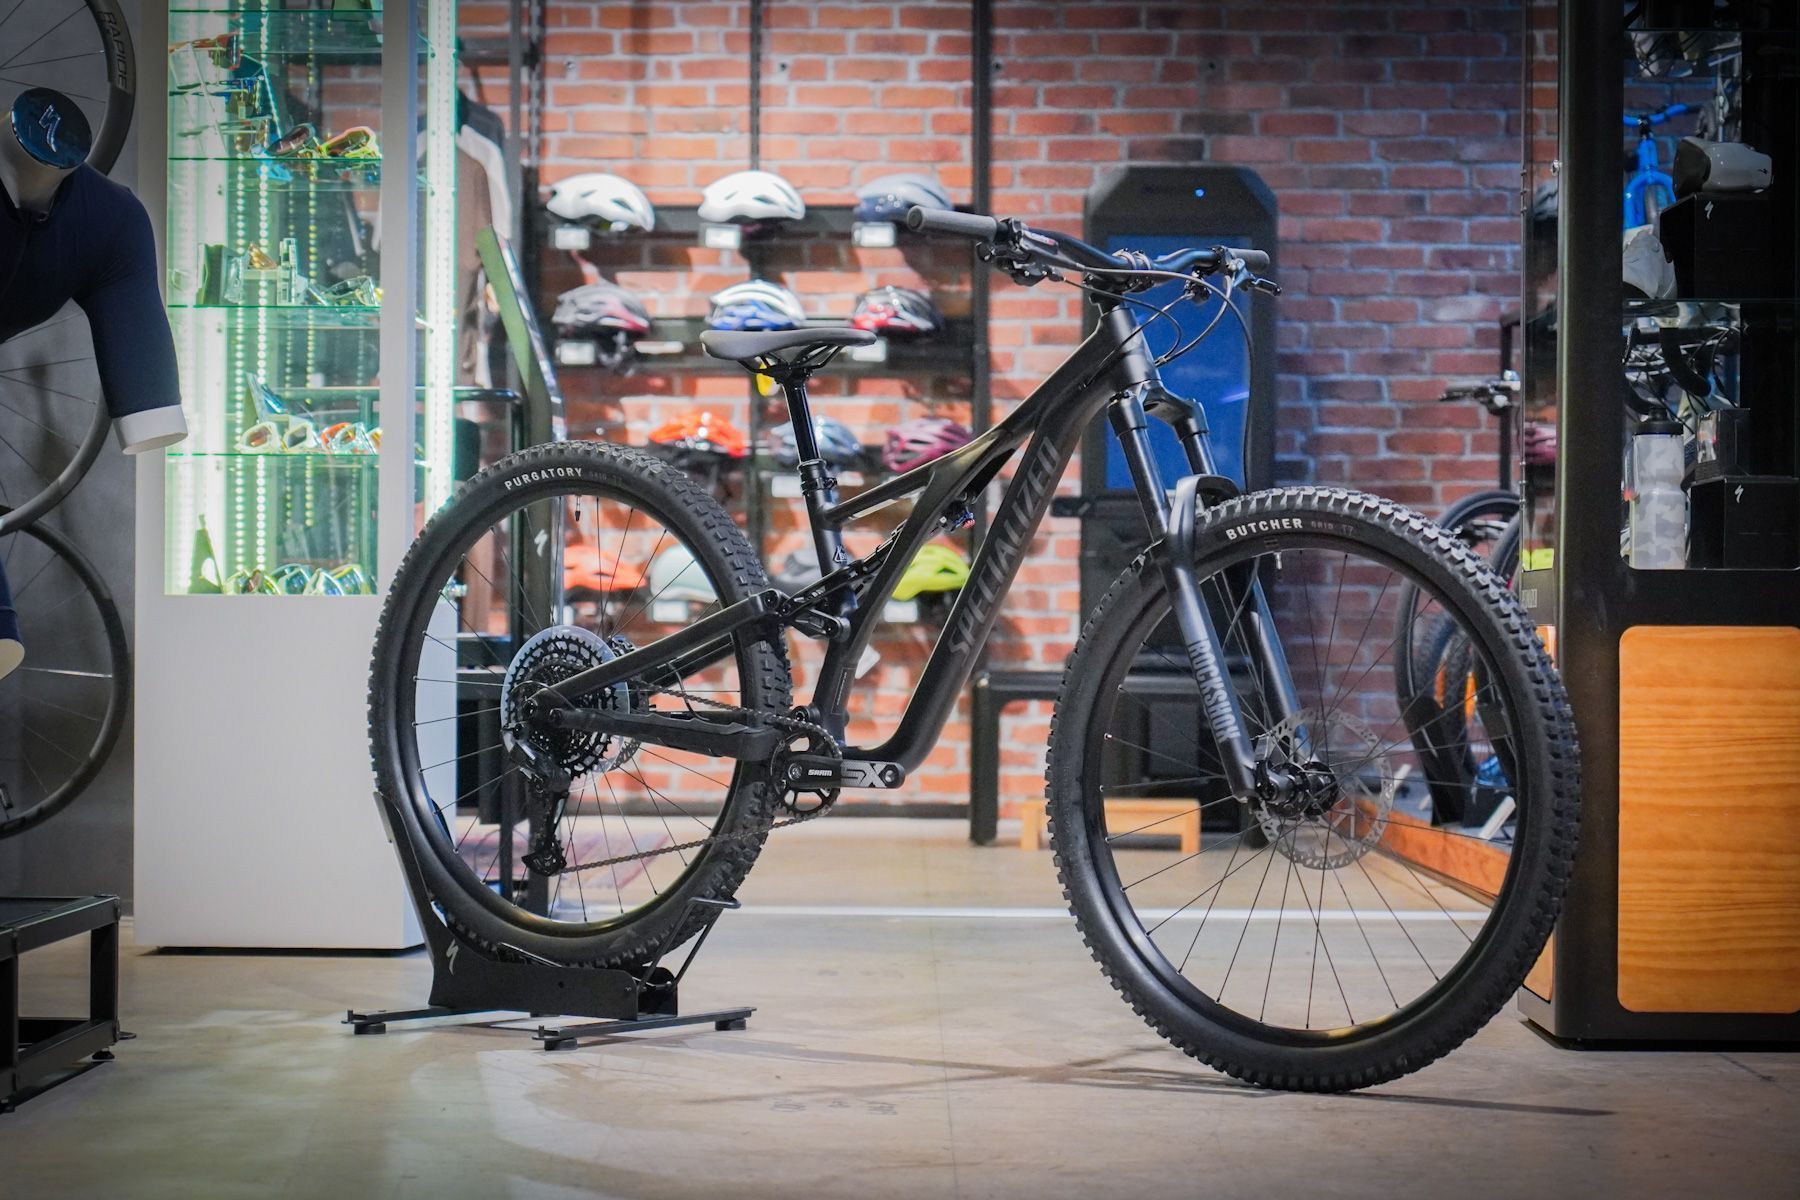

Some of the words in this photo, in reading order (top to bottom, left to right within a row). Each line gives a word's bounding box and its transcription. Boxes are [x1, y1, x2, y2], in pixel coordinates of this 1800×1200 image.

[504, 467, 582, 490] PURGATORY
[1225, 517, 1303, 541] BUTCHER
[948, 436, 1061, 667] SPECIALIZED
[1187, 640, 1241, 743] ROCKSHOX
[807, 768, 833, 777] SRAM
